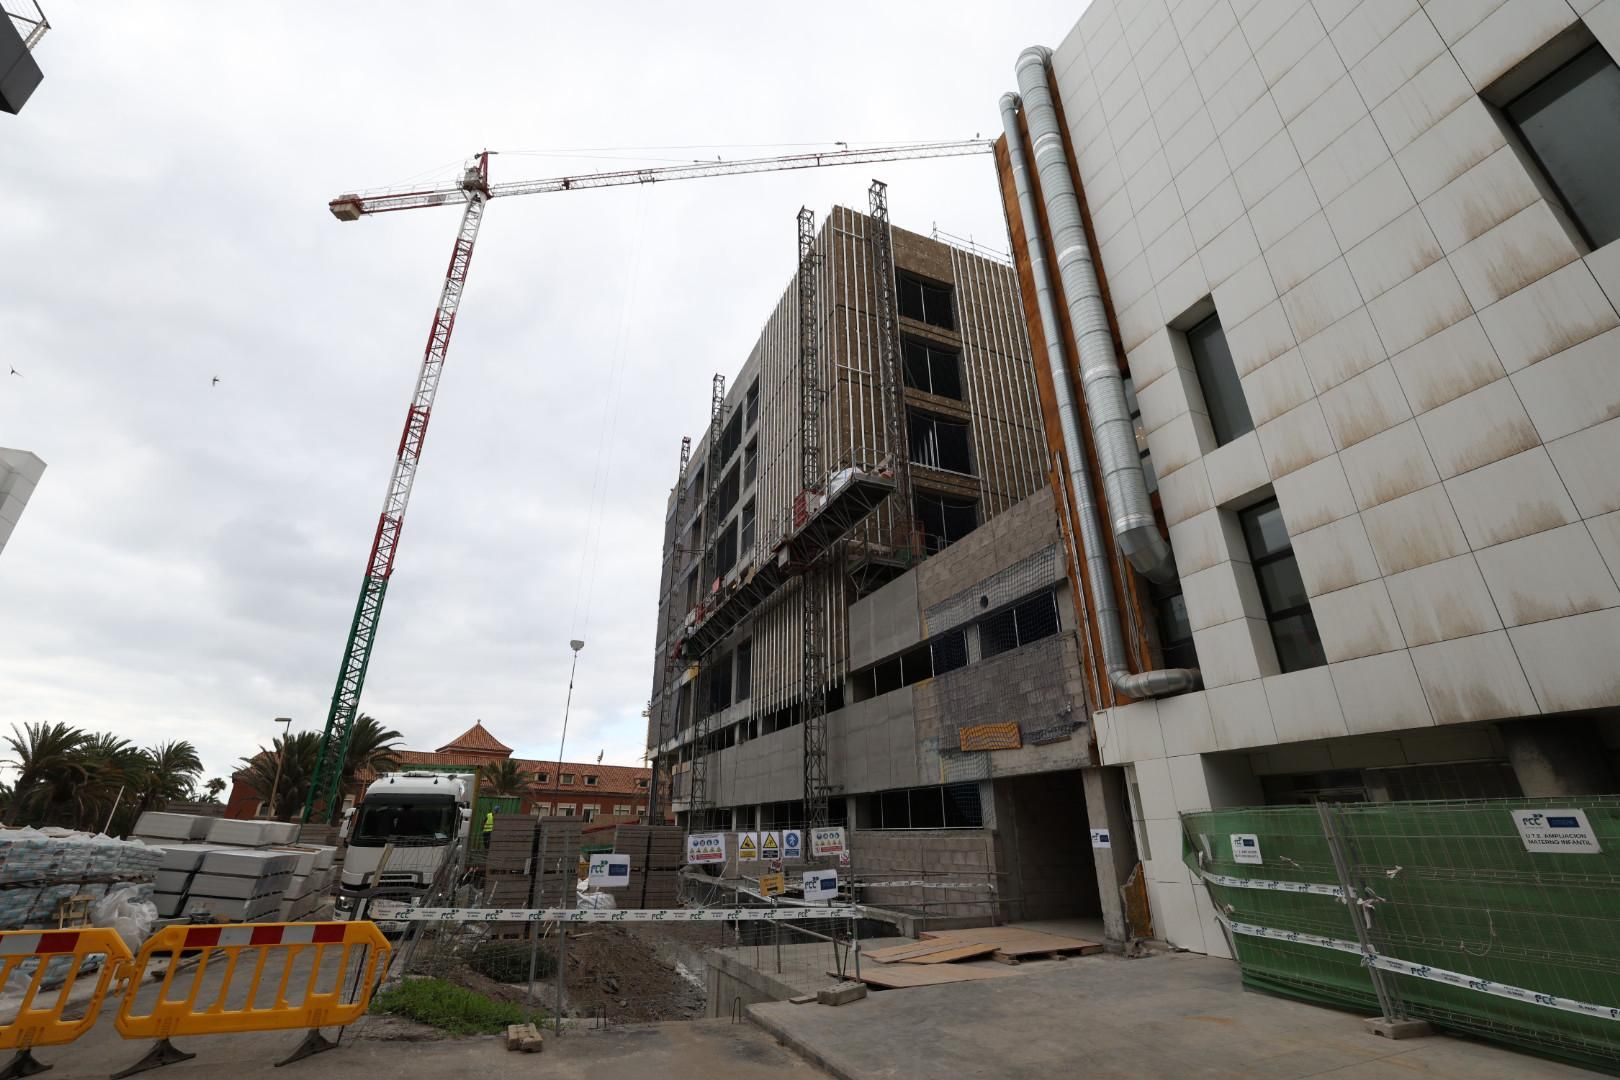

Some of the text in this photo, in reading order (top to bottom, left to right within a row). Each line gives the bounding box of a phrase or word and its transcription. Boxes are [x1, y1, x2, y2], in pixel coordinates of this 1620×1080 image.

[1410, 966, 1429, 978] FCC
[1469, 979, 1489, 991] FCC
[1534, 994, 1557, 1006] FCC
